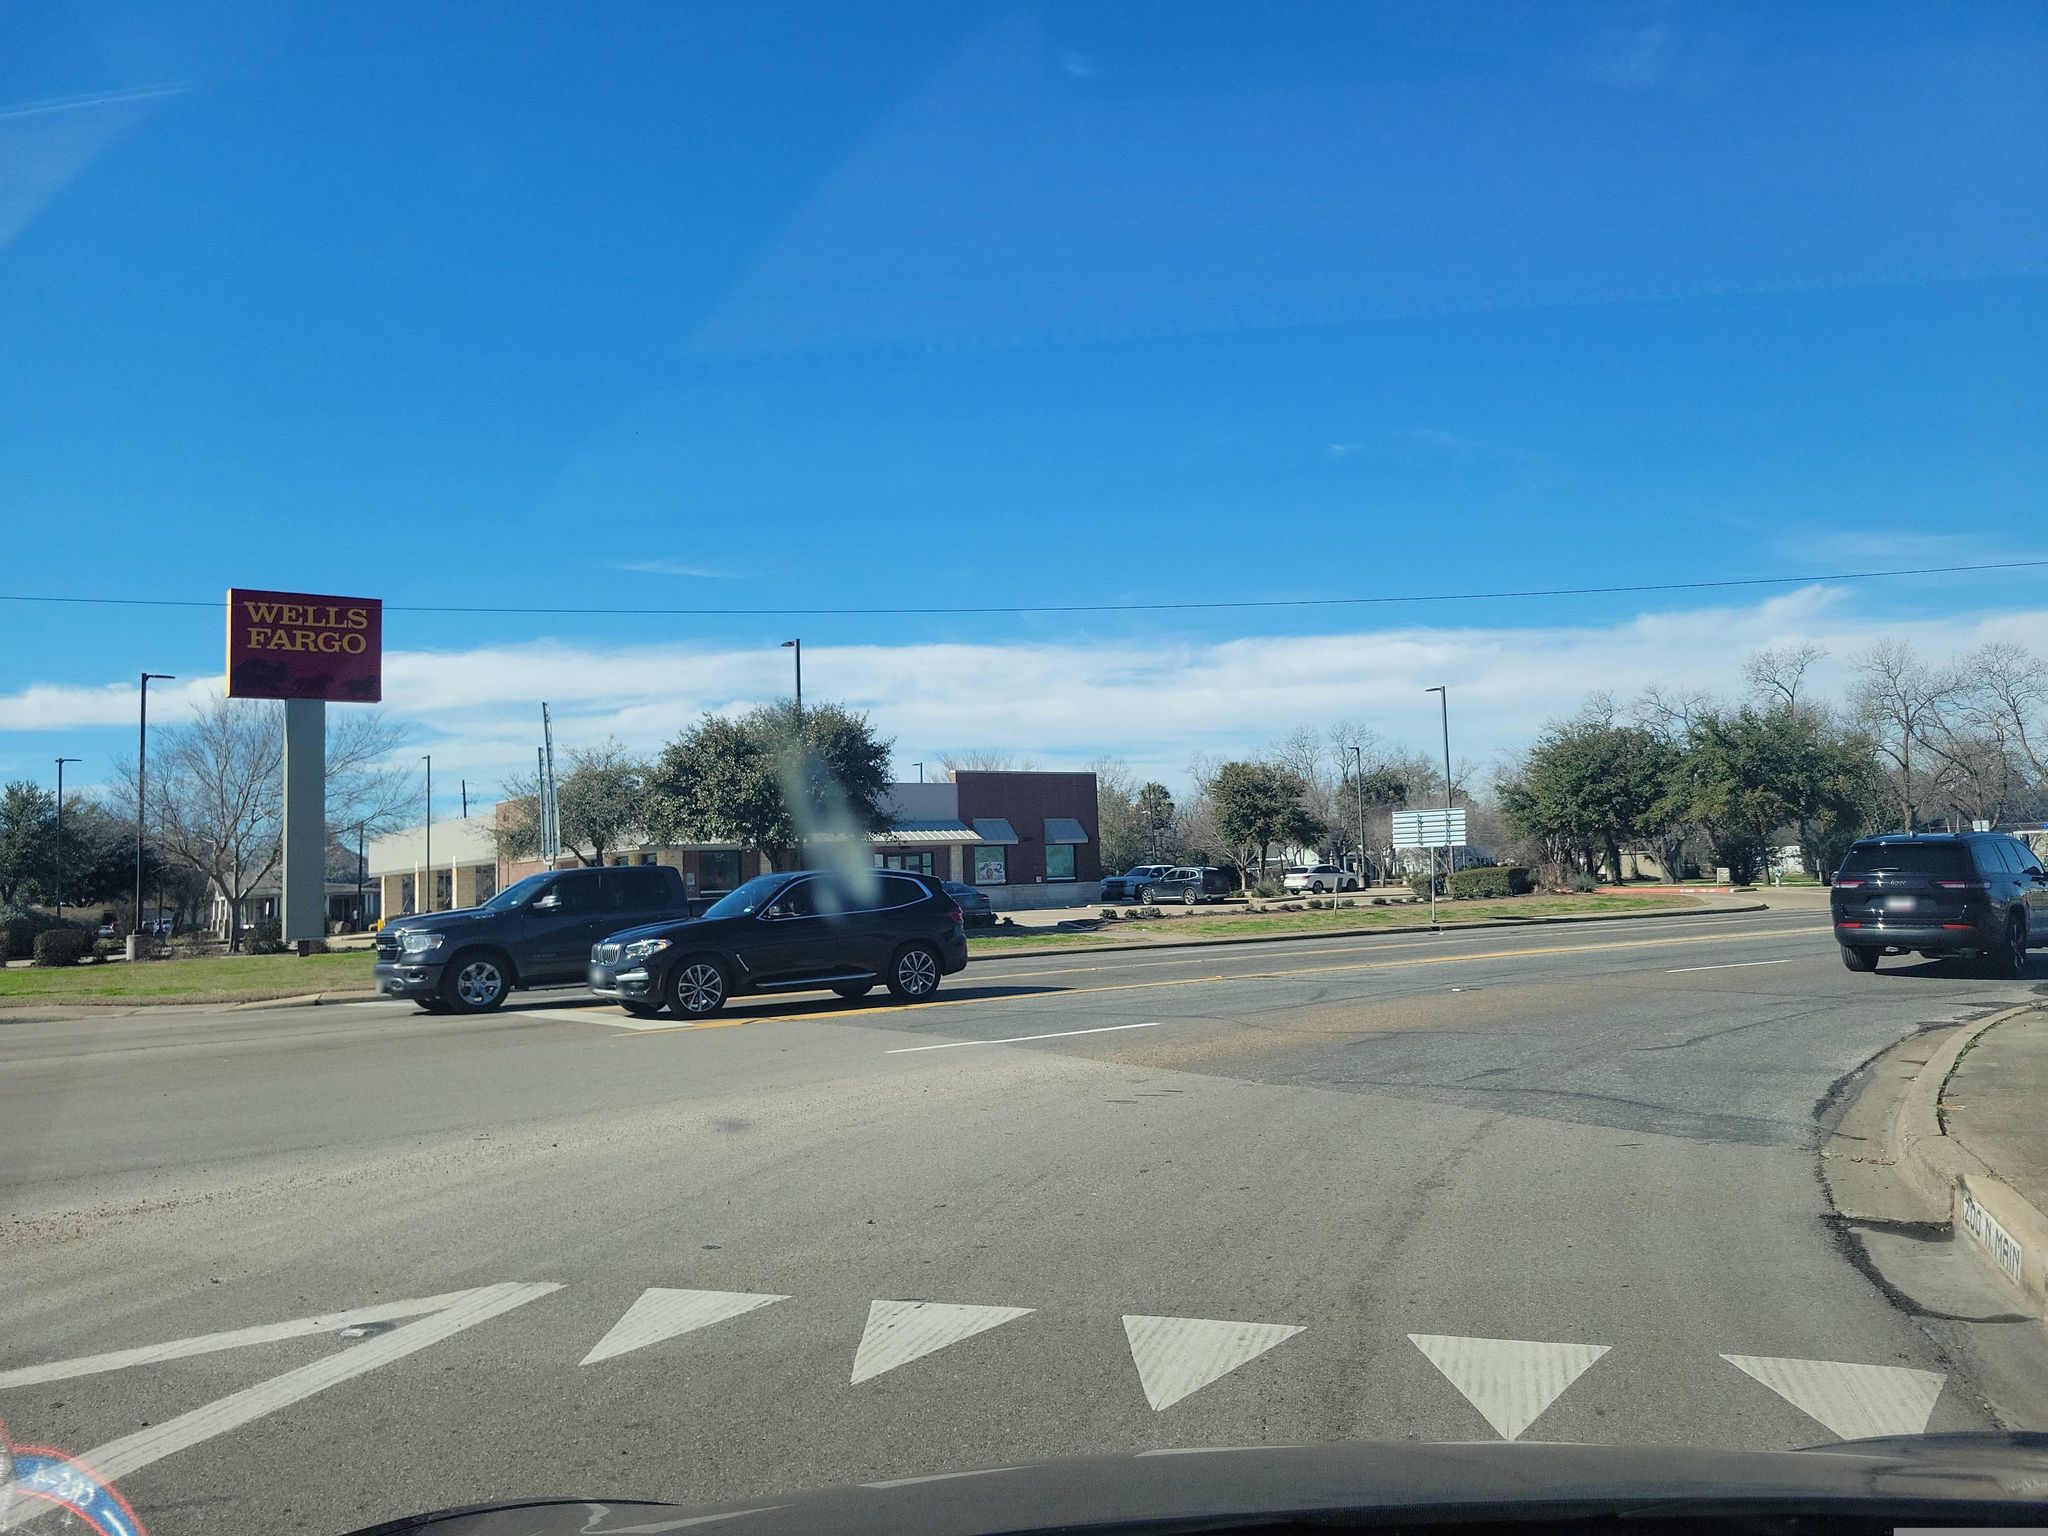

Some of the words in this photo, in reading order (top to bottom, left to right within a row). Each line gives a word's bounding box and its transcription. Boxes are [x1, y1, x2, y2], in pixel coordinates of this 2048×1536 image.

[243, 601, 368, 629] WELLS
[247, 627, 367, 654] FARGO
[1995, 1228, 2020, 1281] MAIN
